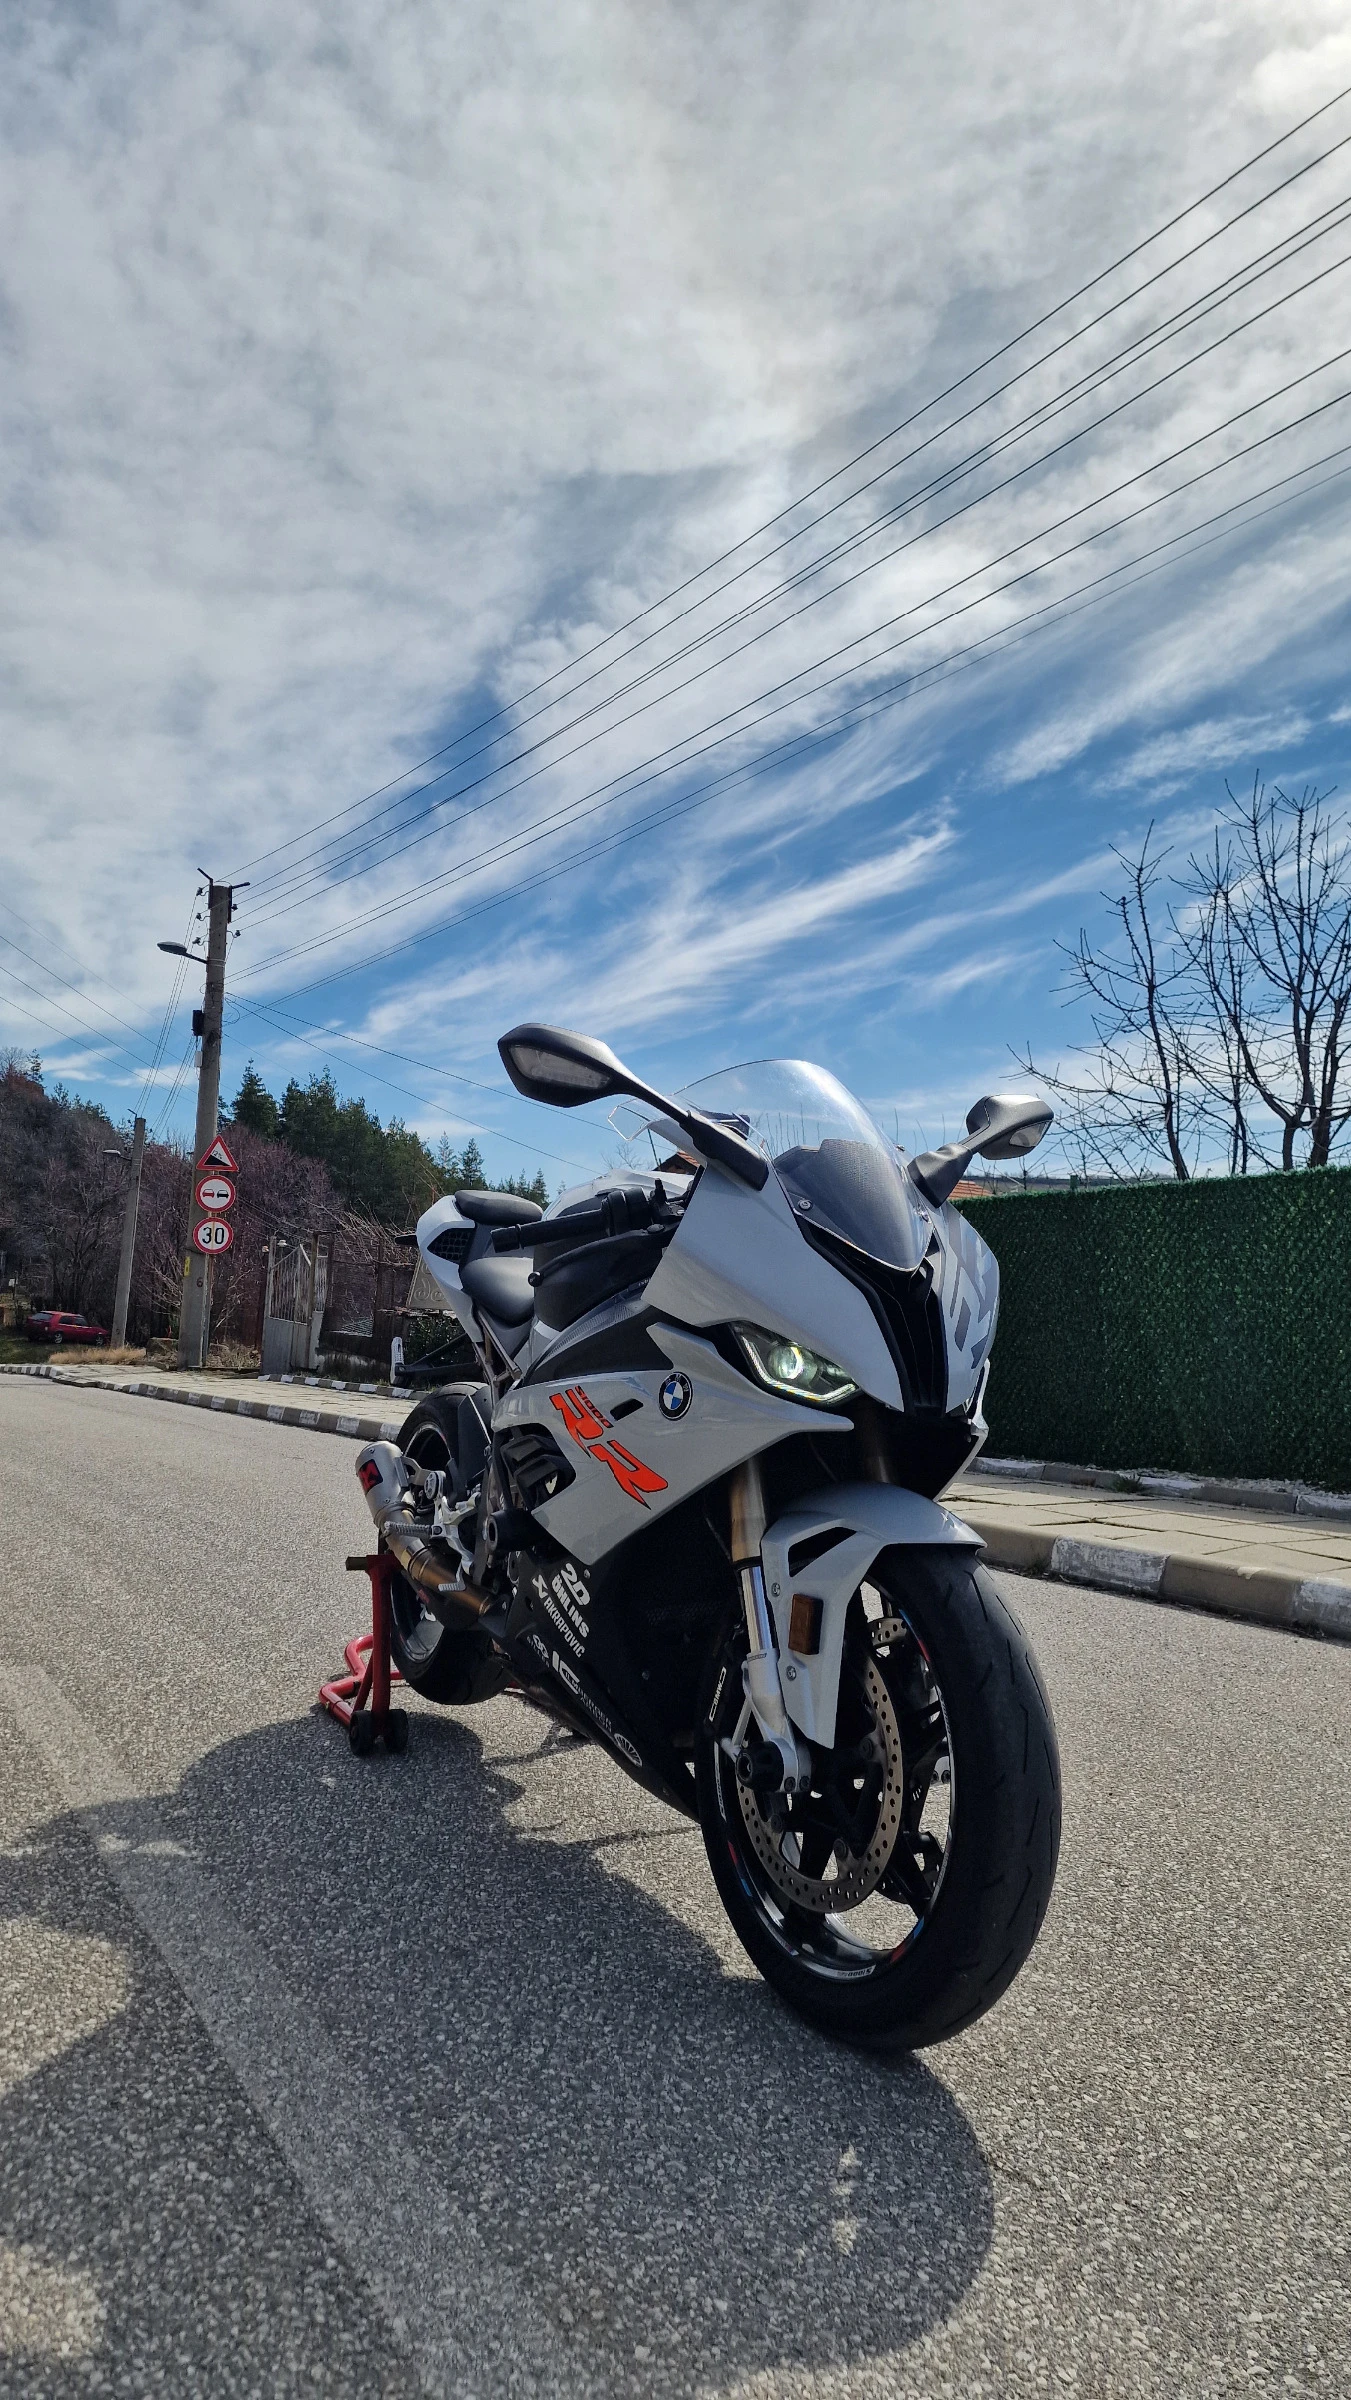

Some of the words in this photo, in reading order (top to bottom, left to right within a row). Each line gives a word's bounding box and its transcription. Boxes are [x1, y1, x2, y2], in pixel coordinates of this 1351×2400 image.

[202, 1227, 225, 1245] 30
[549, 1391, 668, 1510] RR
[551, 1573, 590, 1638] ÖHLINS
[560, 1563, 591, 1606] 2D
[543, 1596, 586, 1658] AKRAPOVIC
